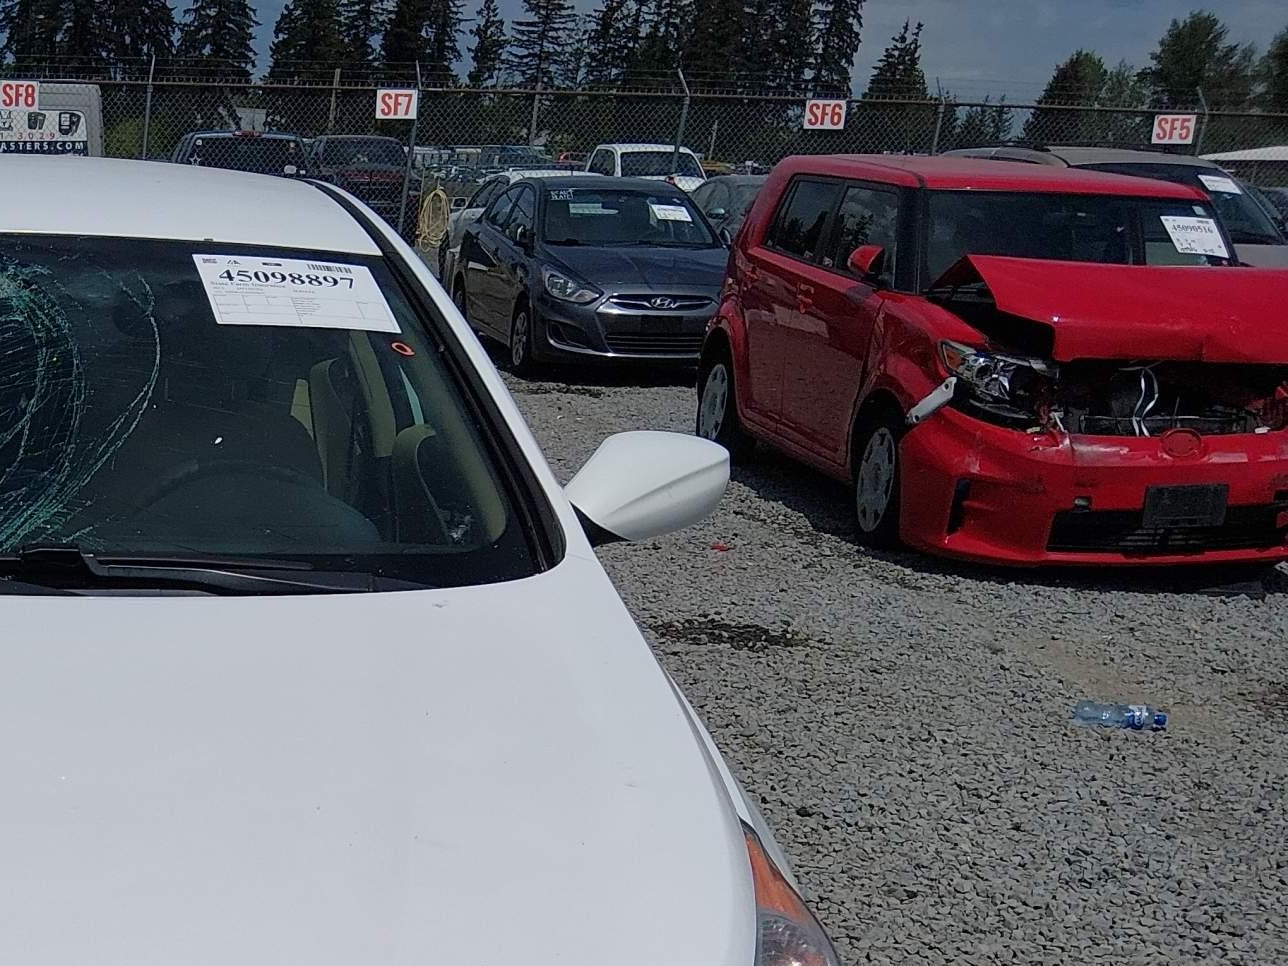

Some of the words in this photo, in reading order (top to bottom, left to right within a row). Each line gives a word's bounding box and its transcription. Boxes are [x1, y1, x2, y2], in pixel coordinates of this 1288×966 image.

[1, 84, 36, 107] SF8
[380, 93, 413, 116] SF7
[807, 103, 843, 126] SF6
[1155, 117, 1192, 140] SF5
[218, 269, 354, 289] 45098897
